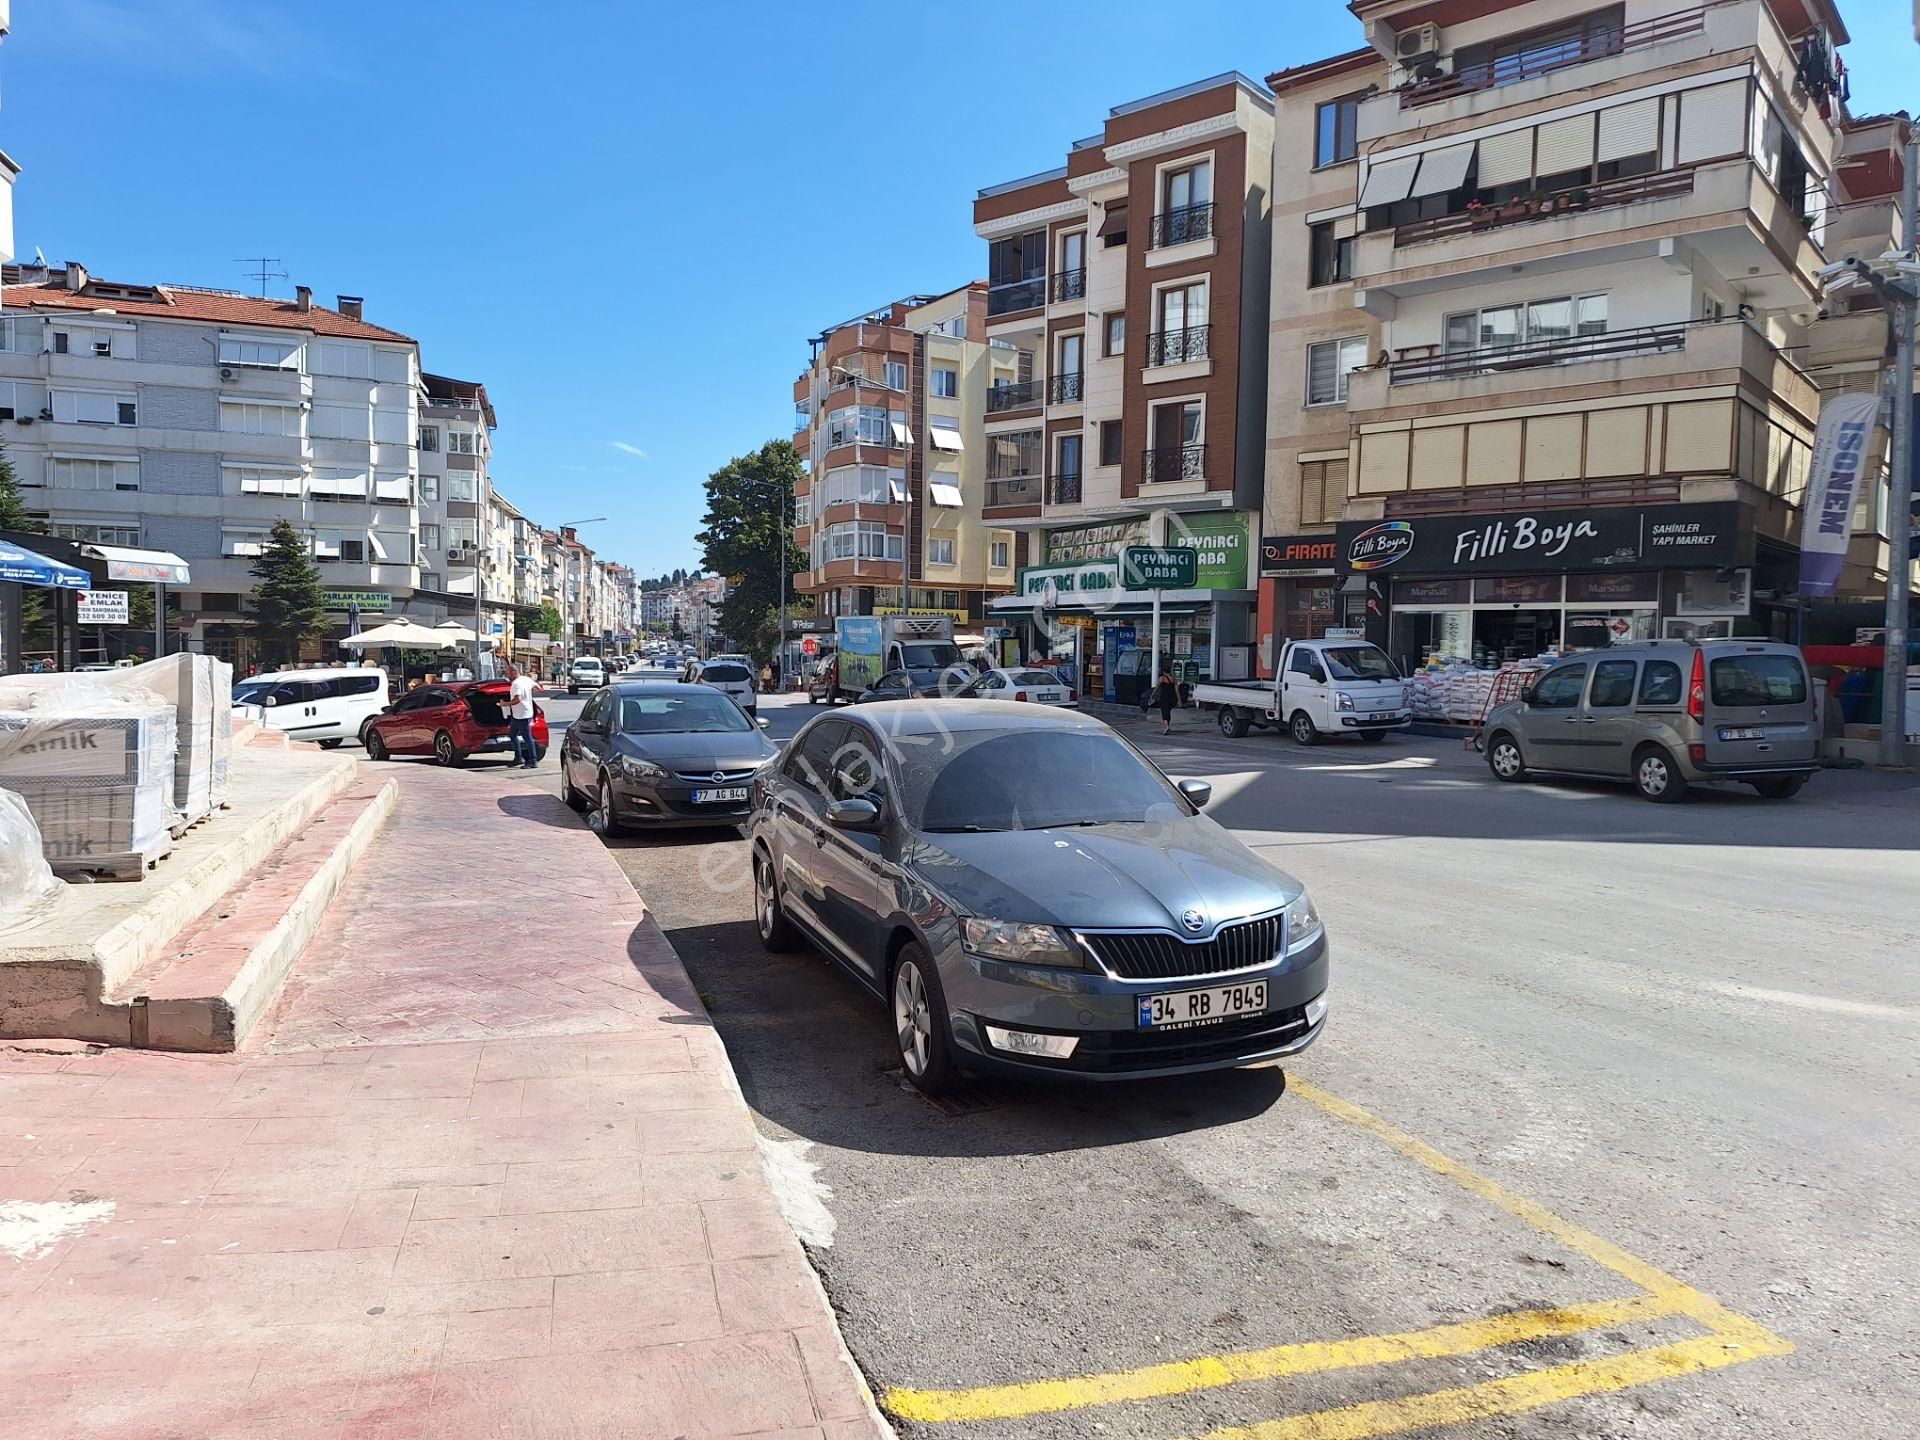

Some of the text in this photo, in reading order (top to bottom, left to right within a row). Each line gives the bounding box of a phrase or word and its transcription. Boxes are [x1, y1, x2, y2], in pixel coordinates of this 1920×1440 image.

[1819, 422, 1866, 535] ISONEM
[1652, 523, 1700, 535] ŞAHİNLER
[1453, 517, 1598, 564] Filli Boya
[1652, 535, 1717, 545] YAPI MARKET
[1353, 535, 1408, 557] Filli Boya
[1197, 552, 1226, 565] ABA
[1145, 567, 1178, 578] BABA
[1411, 588, 1447, 596] Marshall
[1588, 584, 1631, 593] Marshall
[356, 592, 389, 600] PLASTİK
[698, 789, 745, 800] 77 AG 844
[1153, 985, 1264, 1021] 34 RB 7849
[1142, 1013, 1150, 1021] TR
[1159, 1017, 1224, 1031] GALERİ YAVUZ
